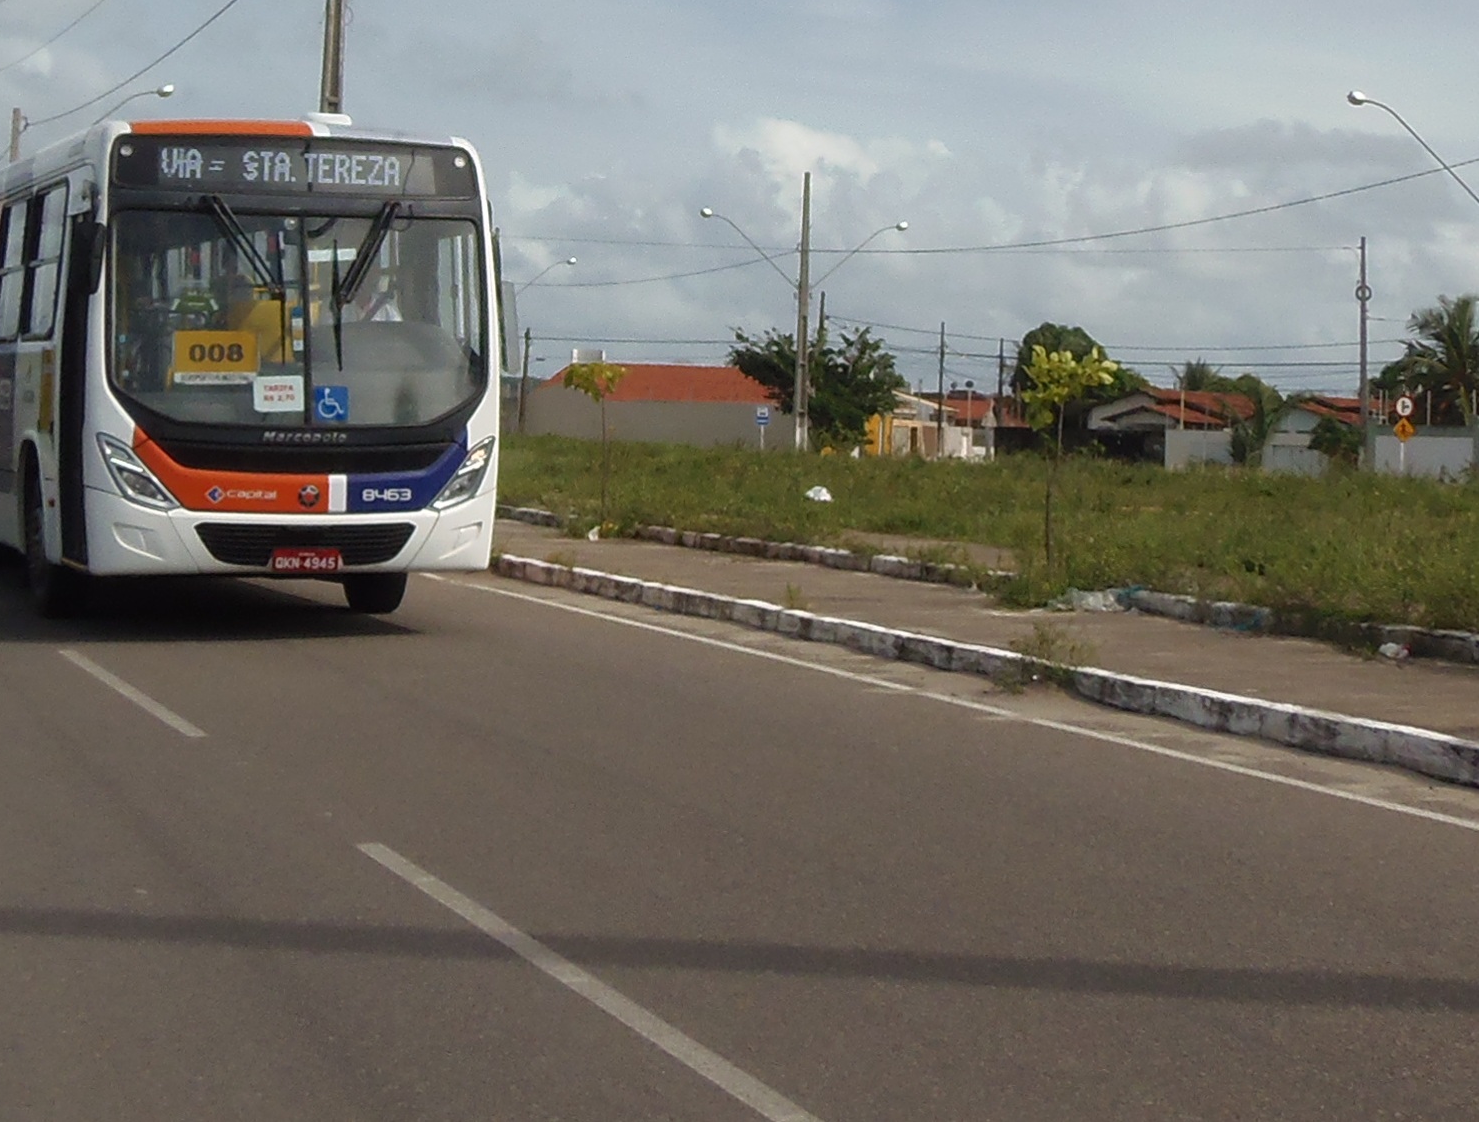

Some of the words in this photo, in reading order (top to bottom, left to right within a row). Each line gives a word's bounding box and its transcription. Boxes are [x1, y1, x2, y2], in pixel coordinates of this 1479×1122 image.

[161, 147, 203, 178] VIA
[241, 150, 297, 182] STA.
[304, 152, 400, 187] TEREZA
[188, 343, 244, 363] 008
[263, 384, 294, 392] TARIFA
[262, 430, 347, 444] Marcopolo
[362, 488, 412, 502] 8463
